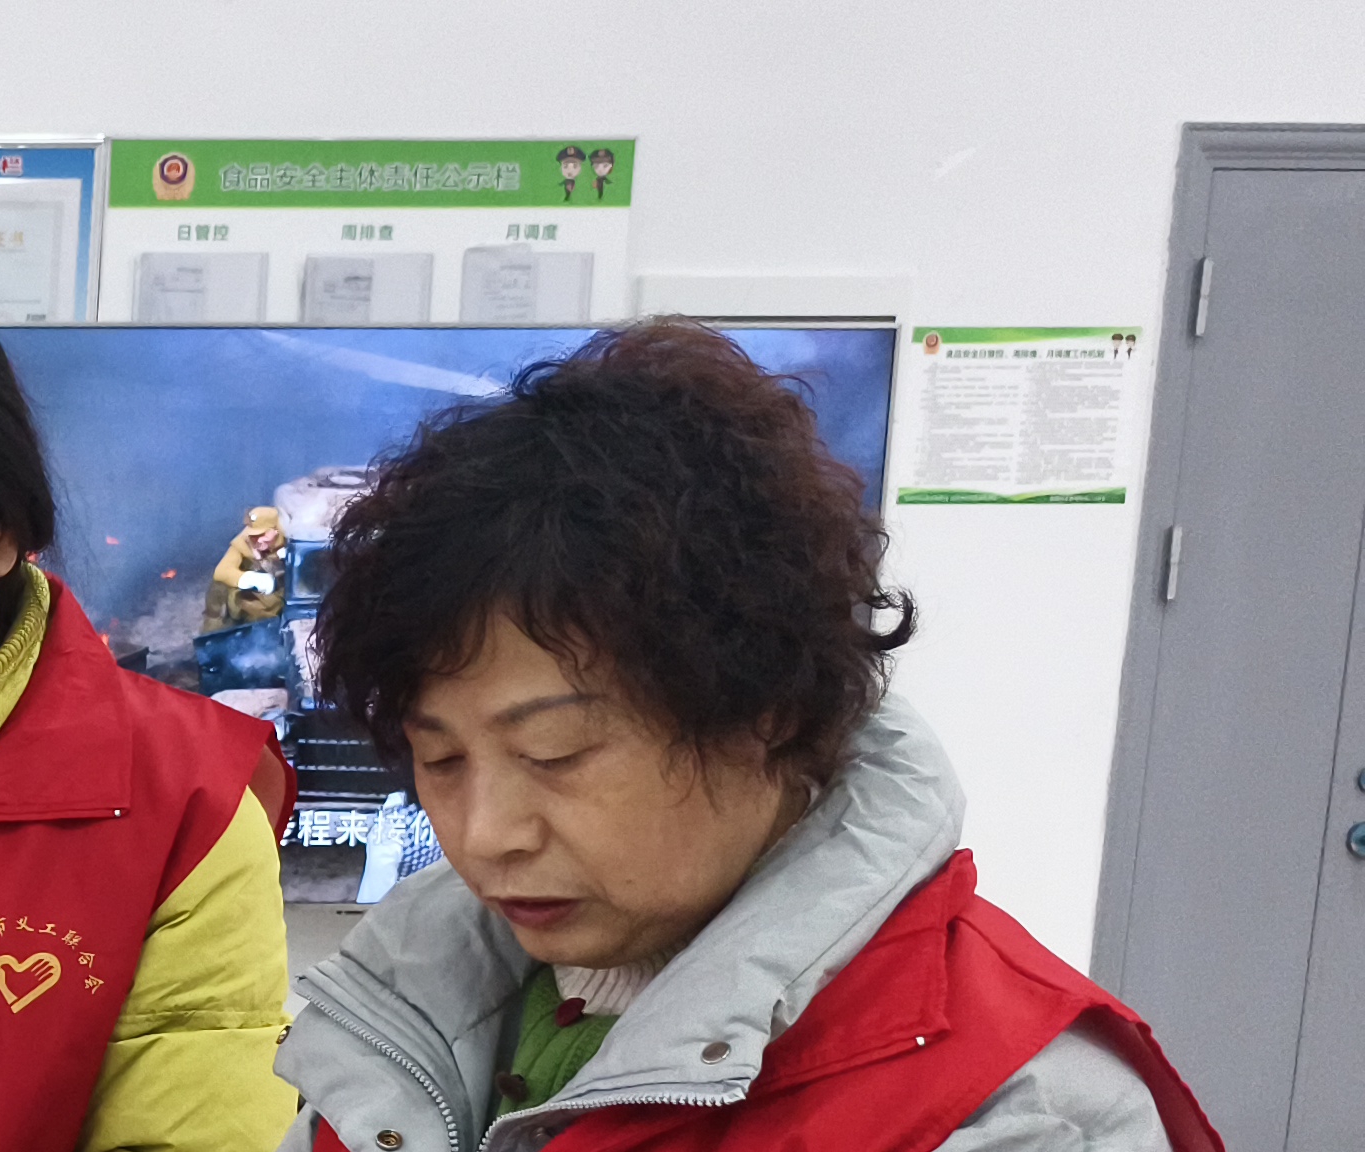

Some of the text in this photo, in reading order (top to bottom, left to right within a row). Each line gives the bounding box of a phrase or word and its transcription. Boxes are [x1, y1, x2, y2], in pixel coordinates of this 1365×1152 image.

[219, 162, 521, 192] 食品安全主体责任公示栏
[177, 224, 229, 242] 日管控
[506, 224, 558, 242] 月调度
